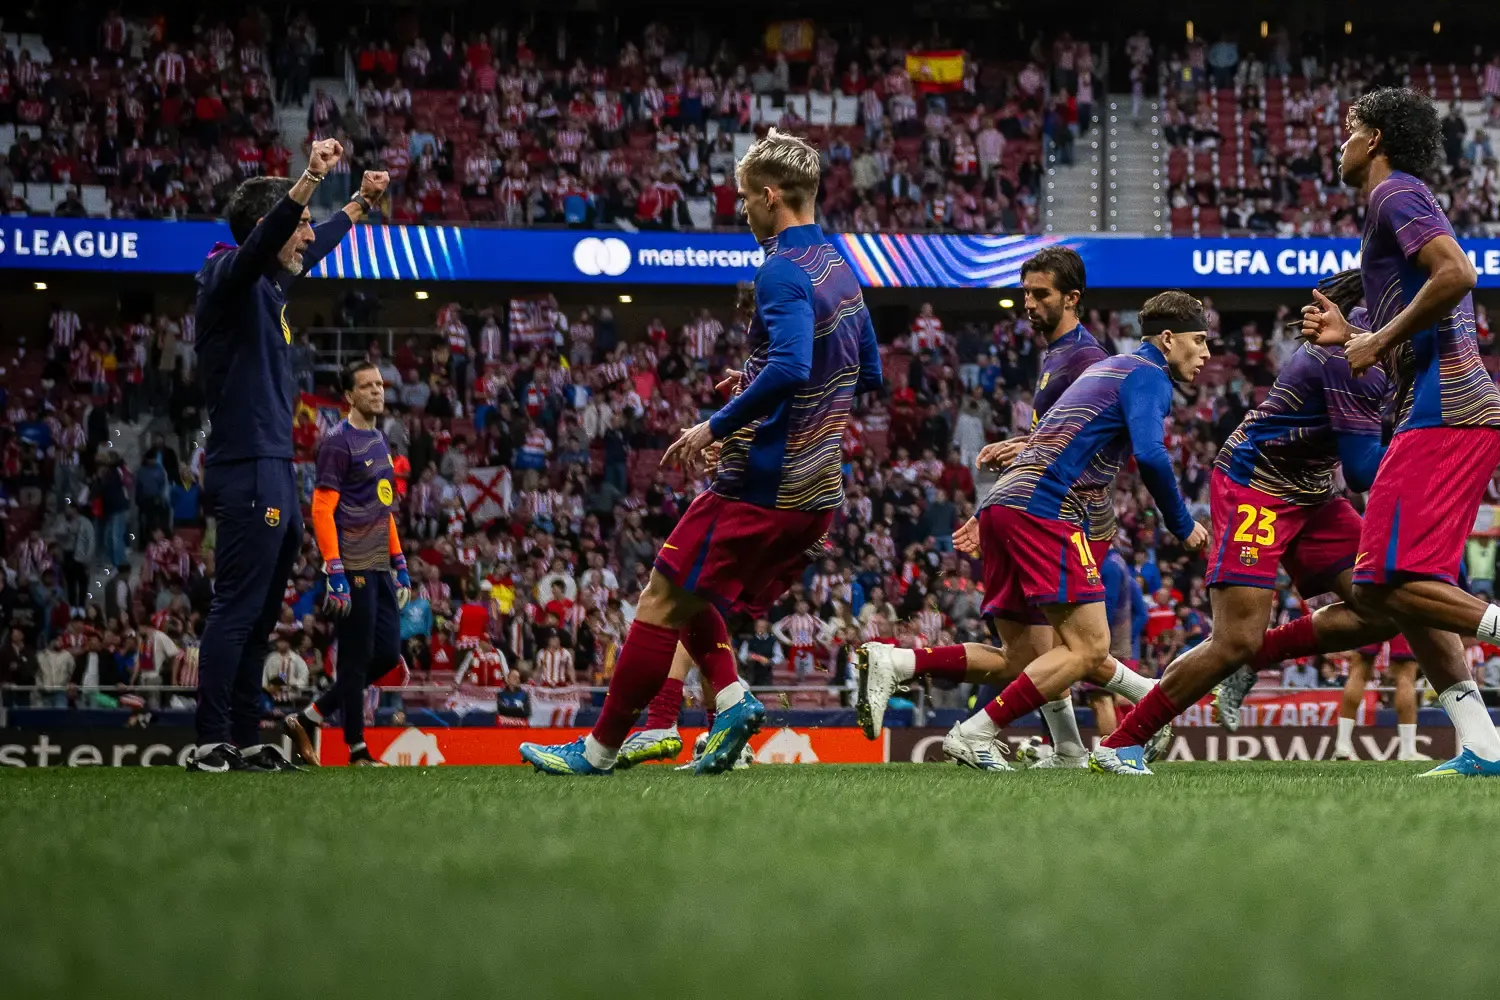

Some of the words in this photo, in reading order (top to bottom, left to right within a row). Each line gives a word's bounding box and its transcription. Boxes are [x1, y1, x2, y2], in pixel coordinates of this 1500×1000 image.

[14, 229, 139, 260] LEAGUE
[638, 245, 765, 268] mastercard
[1192, 249, 1271, 276] UEFA
[1233, 503, 1278, 547] 23
